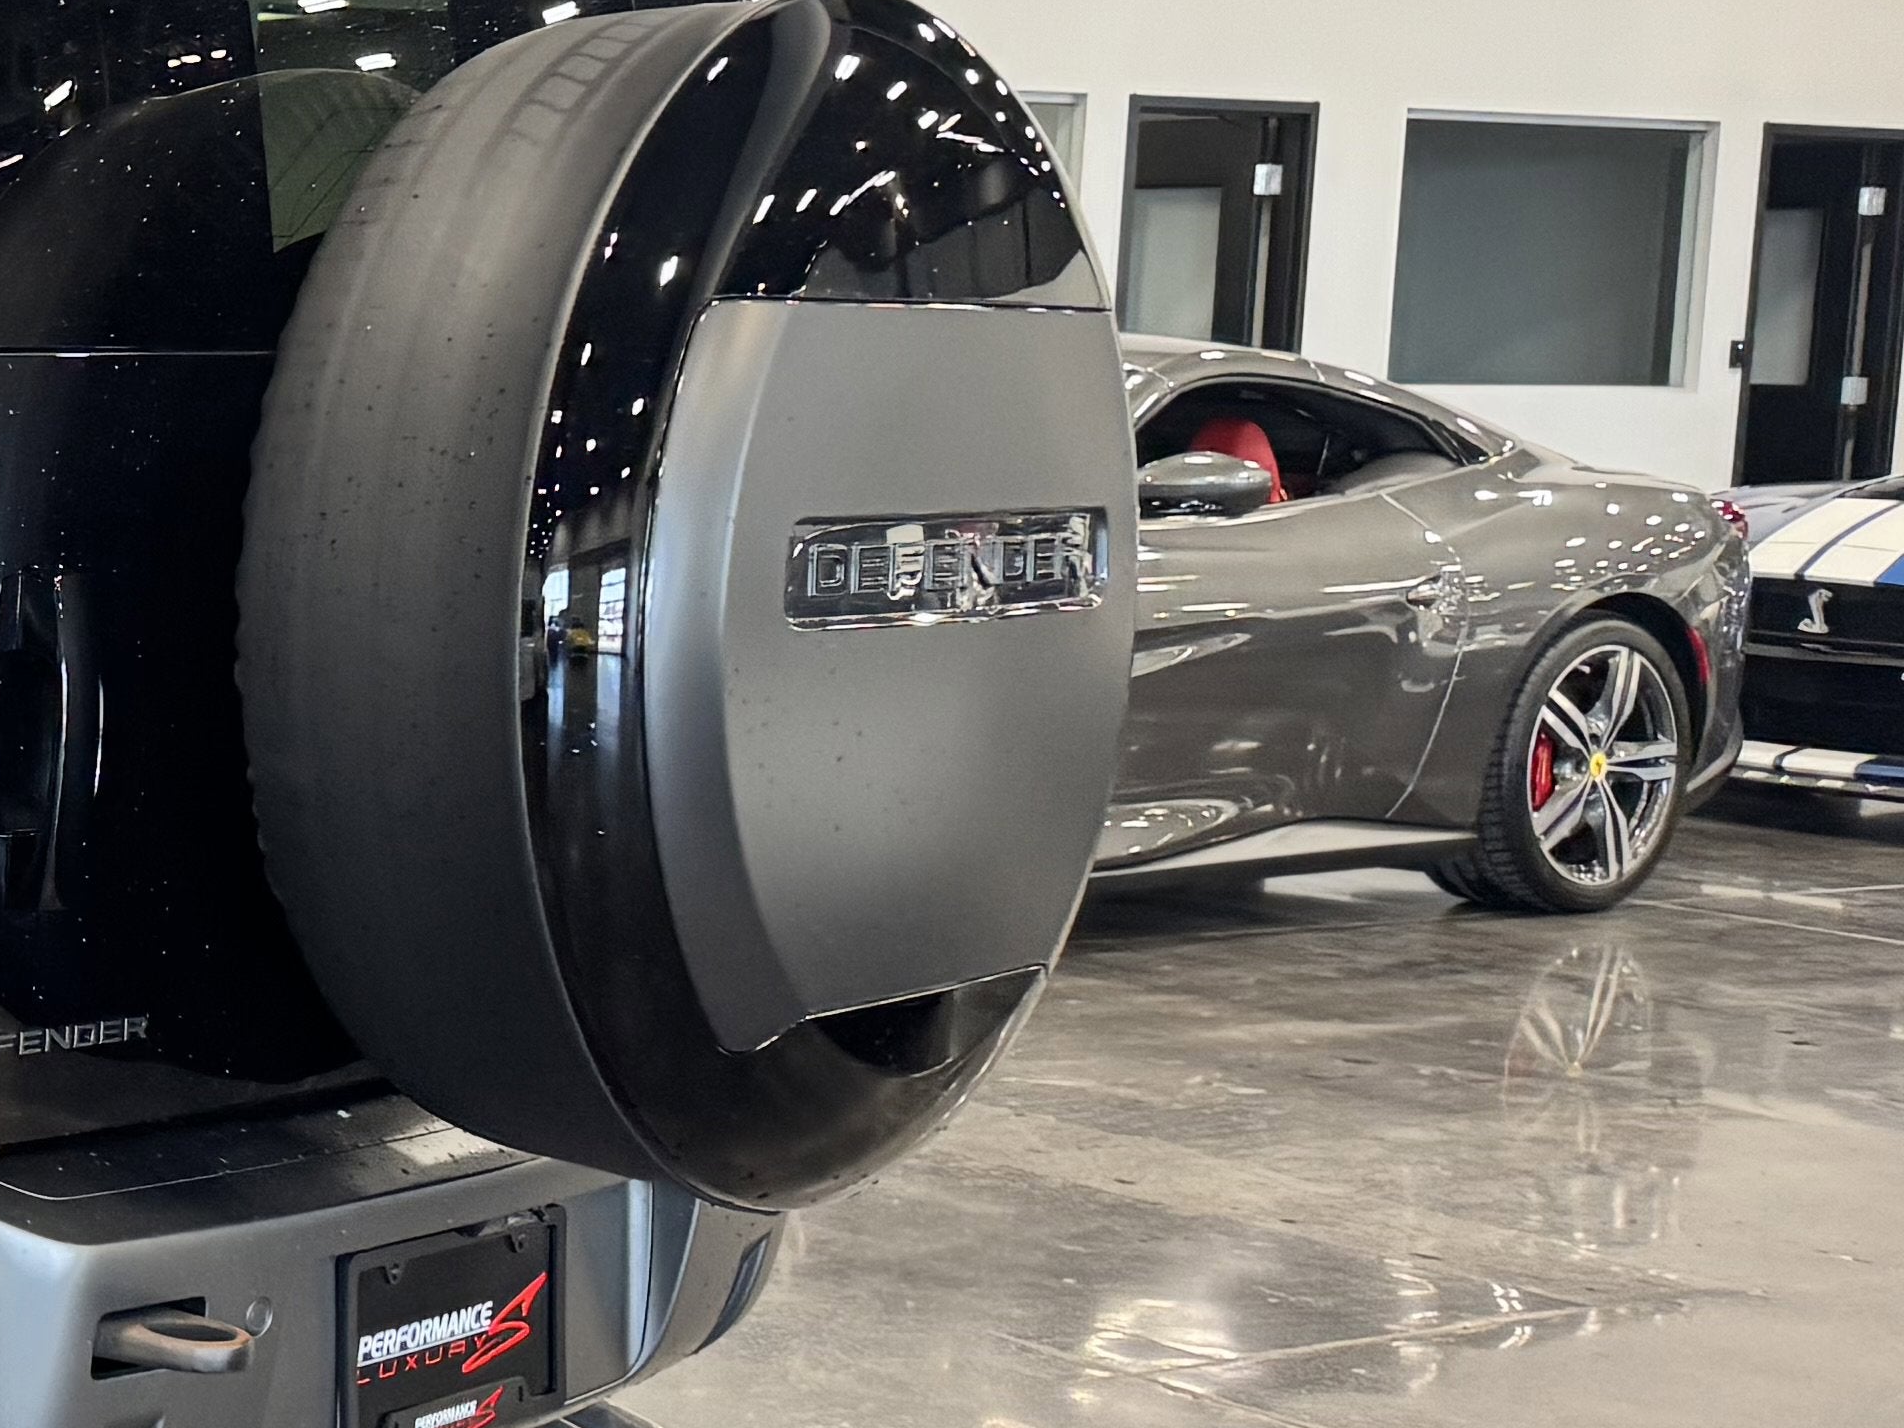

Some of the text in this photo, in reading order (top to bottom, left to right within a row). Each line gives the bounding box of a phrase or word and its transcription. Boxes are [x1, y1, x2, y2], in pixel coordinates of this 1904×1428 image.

[806, 531, 1092, 598] DEFENDER
[356, 1333, 488, 1386] LUXURY
[357, 1300, 494, 1367] PERFORMANCE
